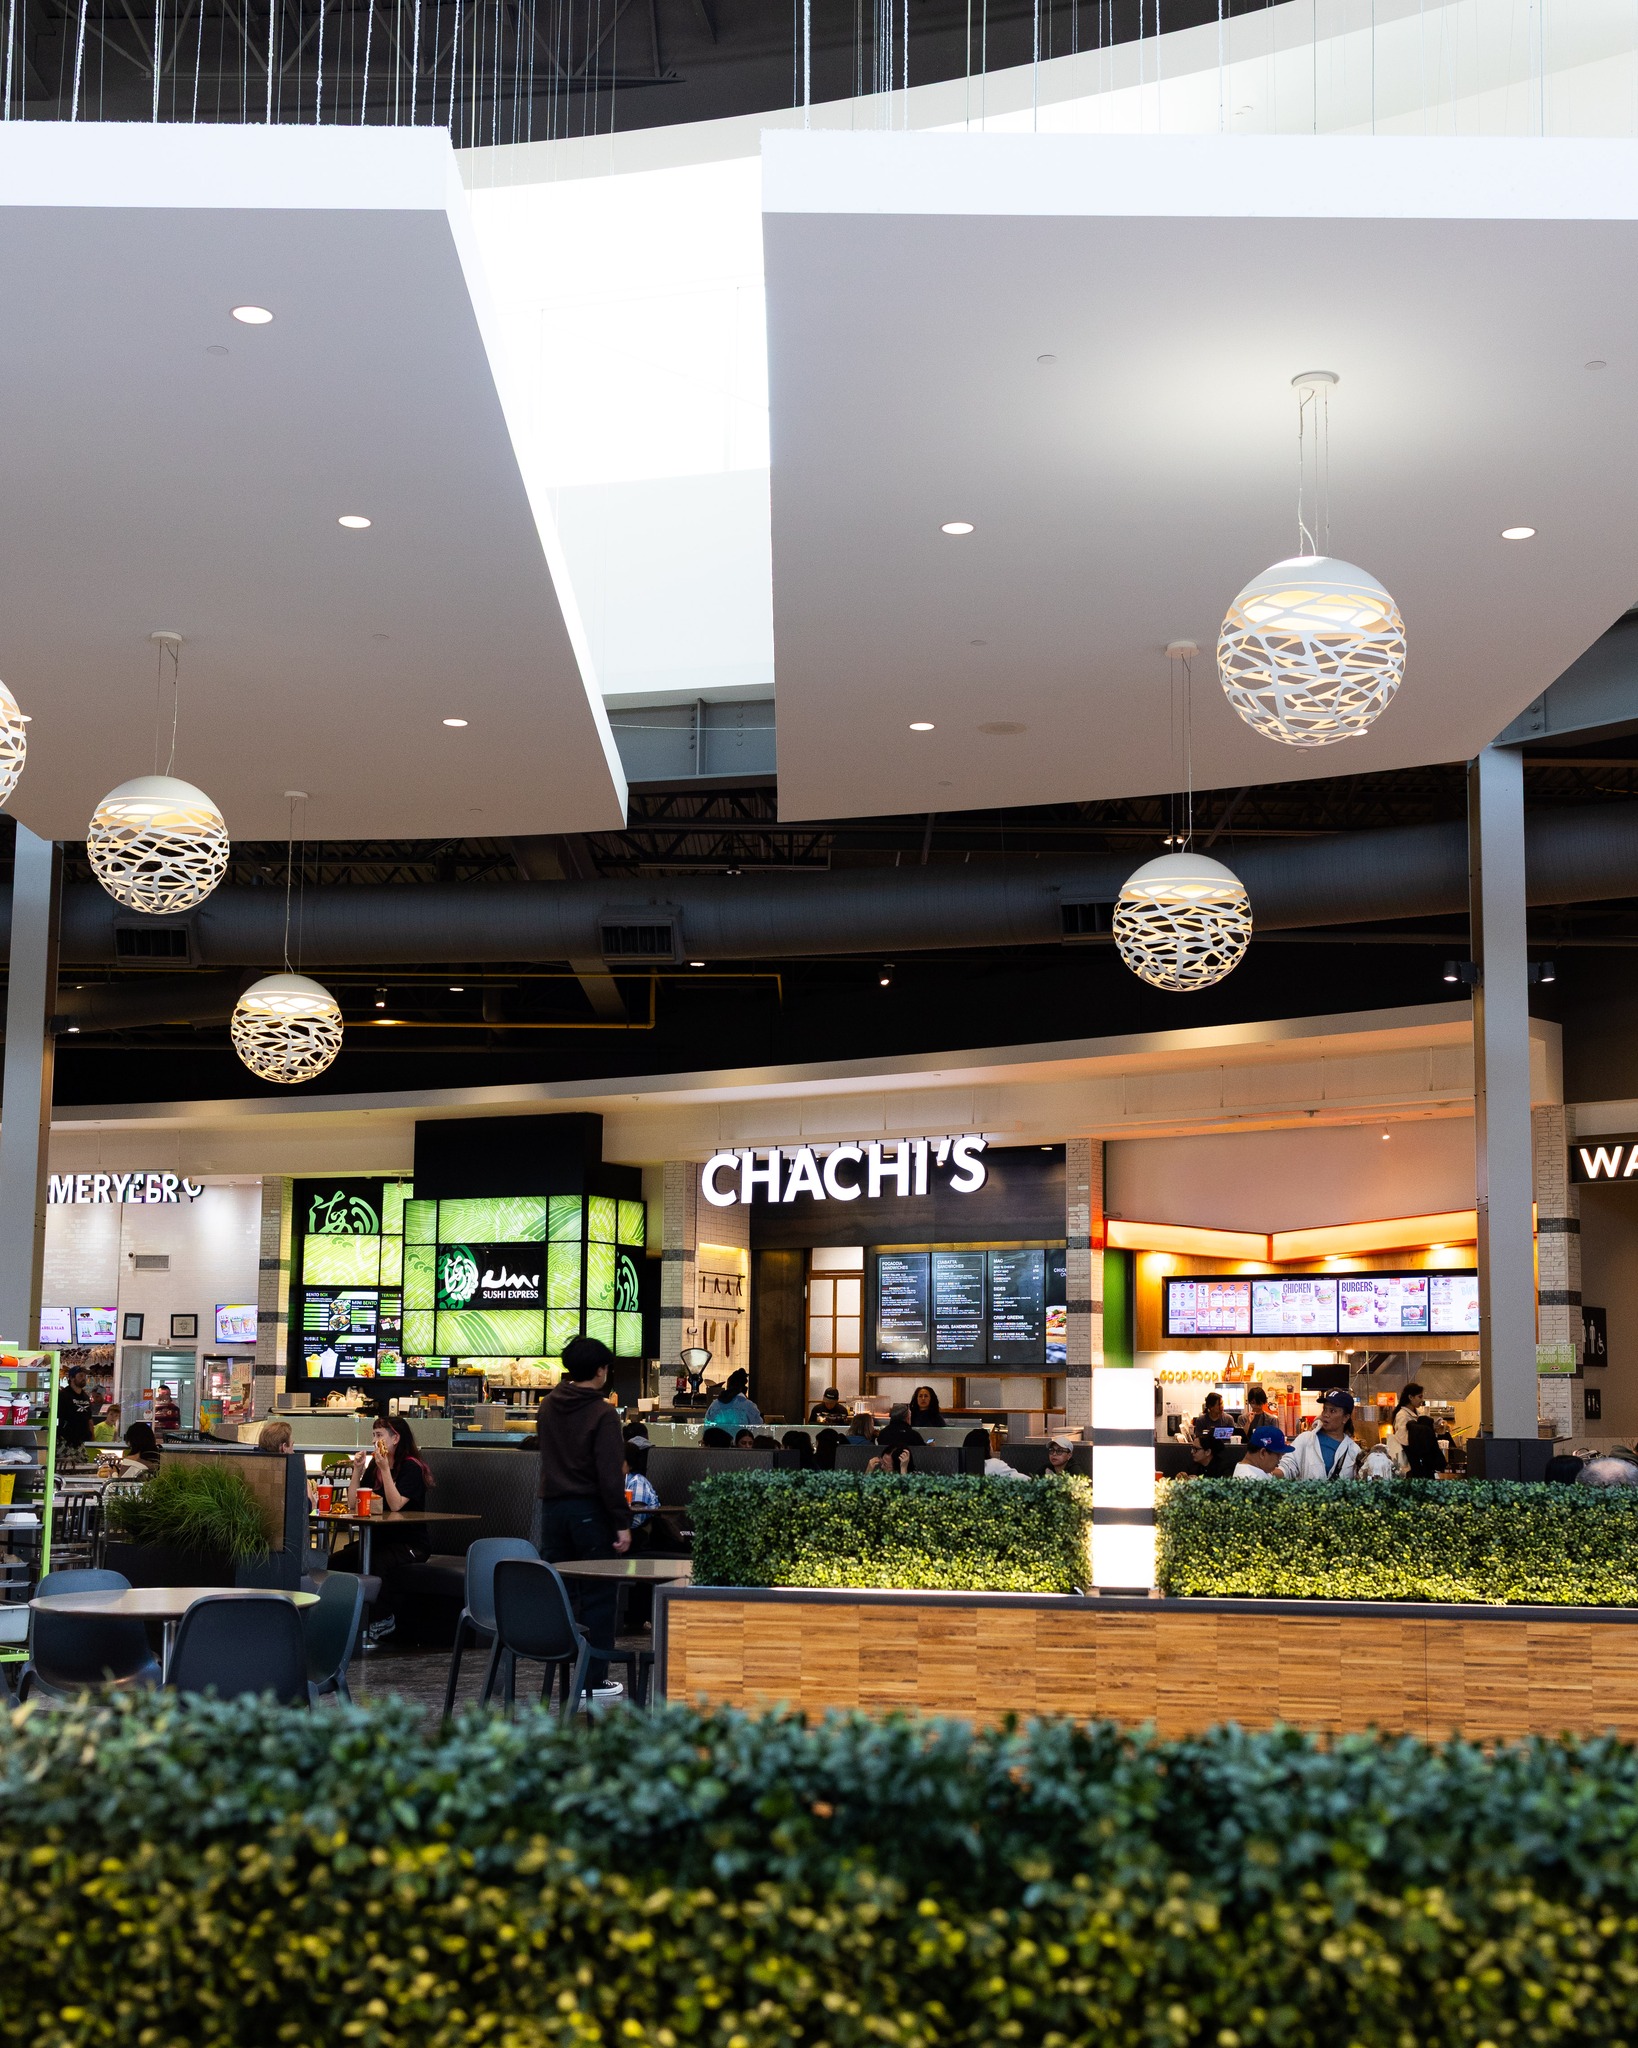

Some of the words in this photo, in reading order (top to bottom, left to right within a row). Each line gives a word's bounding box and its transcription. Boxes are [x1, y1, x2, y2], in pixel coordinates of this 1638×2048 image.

[701, 1137, 988, 1206] CHACHI'S
[1282, 1282, 1312, 1293] CHICKEN
[1341, 1281, 1373, 1293] BURGERS
[482, 1290, 506, 1299] SUSHI
[507, 1289, 539, 1299] EXPRESS
[1160, 1369, 1188, 1384] GOOD
[1191, 1369, 1219, 1384] FOOD
